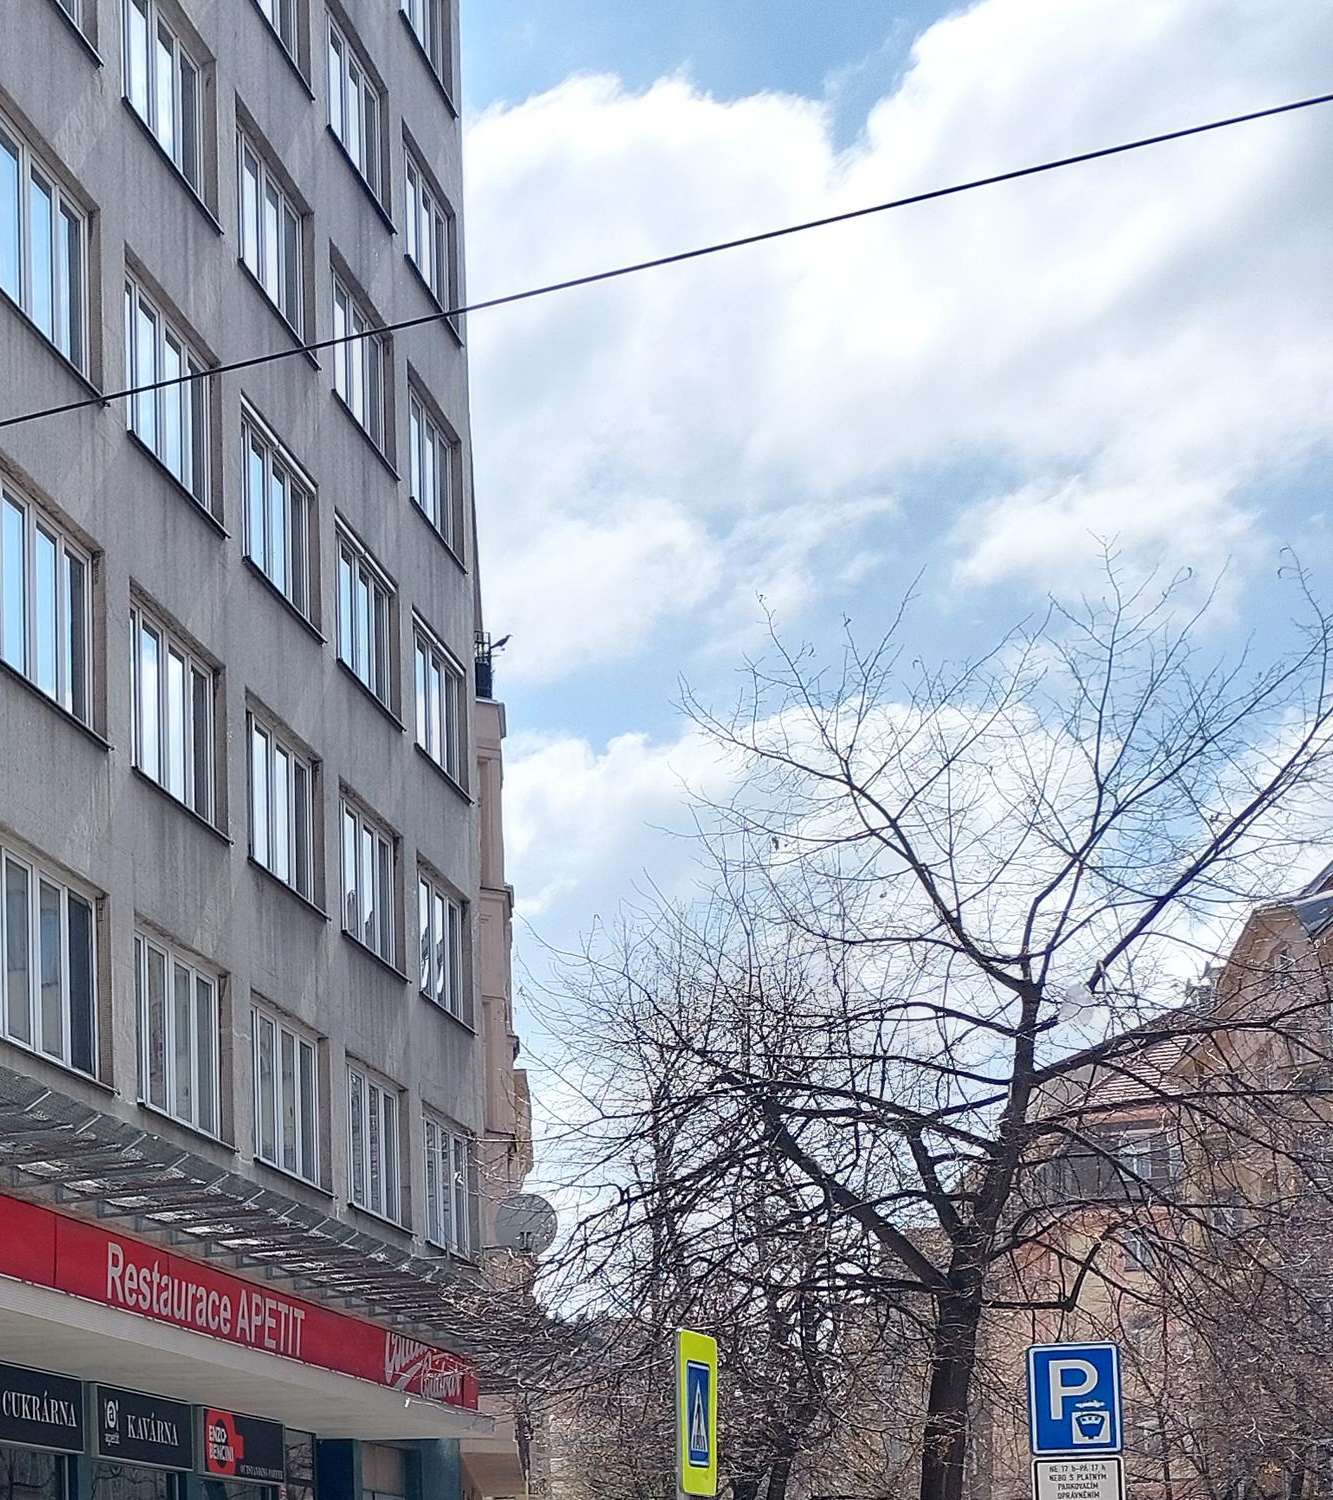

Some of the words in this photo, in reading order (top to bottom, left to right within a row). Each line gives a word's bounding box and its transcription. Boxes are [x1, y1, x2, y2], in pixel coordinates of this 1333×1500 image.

[106, 1240, 232, 1336] Restaurace
[236, 1288, 306, 1358] APETIT
[2, 1389, 78, 1429] CUKRÁRNA
[1048, 1358, 1099, 1421] P
[126, 1411, 180, 1447] KAVÁRNA
[209, 1445, 233, 1463] BENCINI
